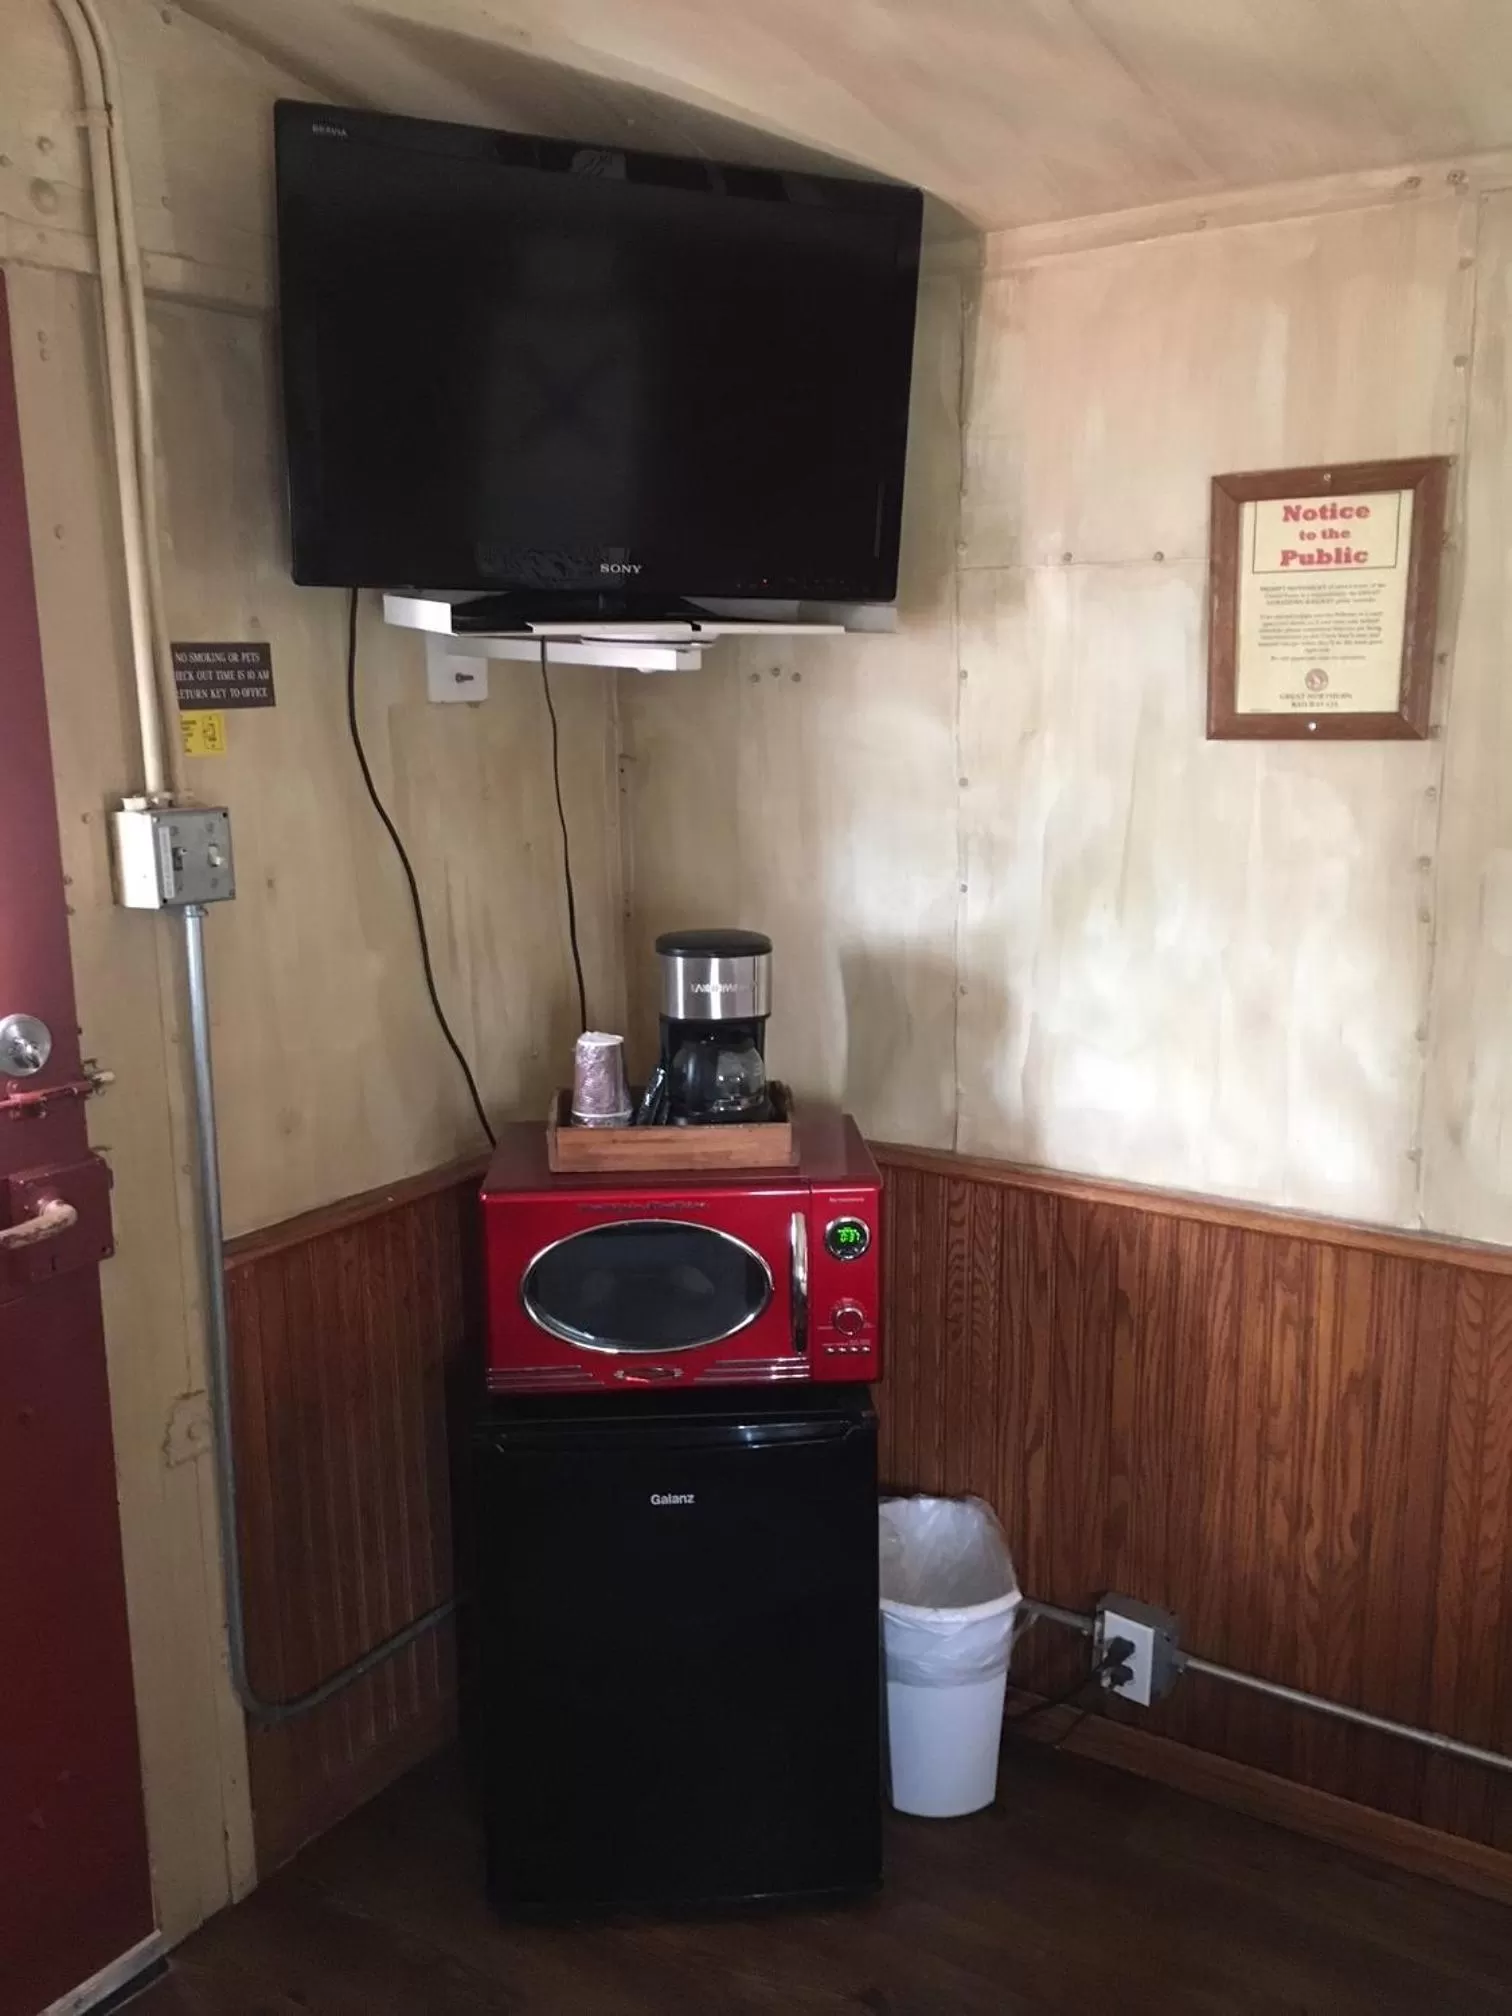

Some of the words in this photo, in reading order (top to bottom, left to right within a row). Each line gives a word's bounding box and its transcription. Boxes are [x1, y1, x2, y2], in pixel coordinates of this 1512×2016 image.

[1282, 502, 1371, 522] Notice
[1299, 530, 1316, 541] to
[1321, 528, 1351, 540] the
[1280, 547, 1369, 567] Public
[600, 563, 642, 574] SONY
[175, 652, 187, 663] NO
[188, 651, 226, 663] SMOKING
[227, 652, 239, 663] OR
[241, 651, 260, 663] PETS
[175, 670, 194, 681] HECK
[196, 670, 213, 680] OUT
[215, 670, 236, 680] TIME
[237, 669, 245, 680] IS
[178, 688, 208, 700] ETURN
[210, 688, 227, 698] KEY
[229, 688, 240, 698] TO
[241, 687, 268, 698] OFFICE
[650, 1493, 695, 1505] Galanz
